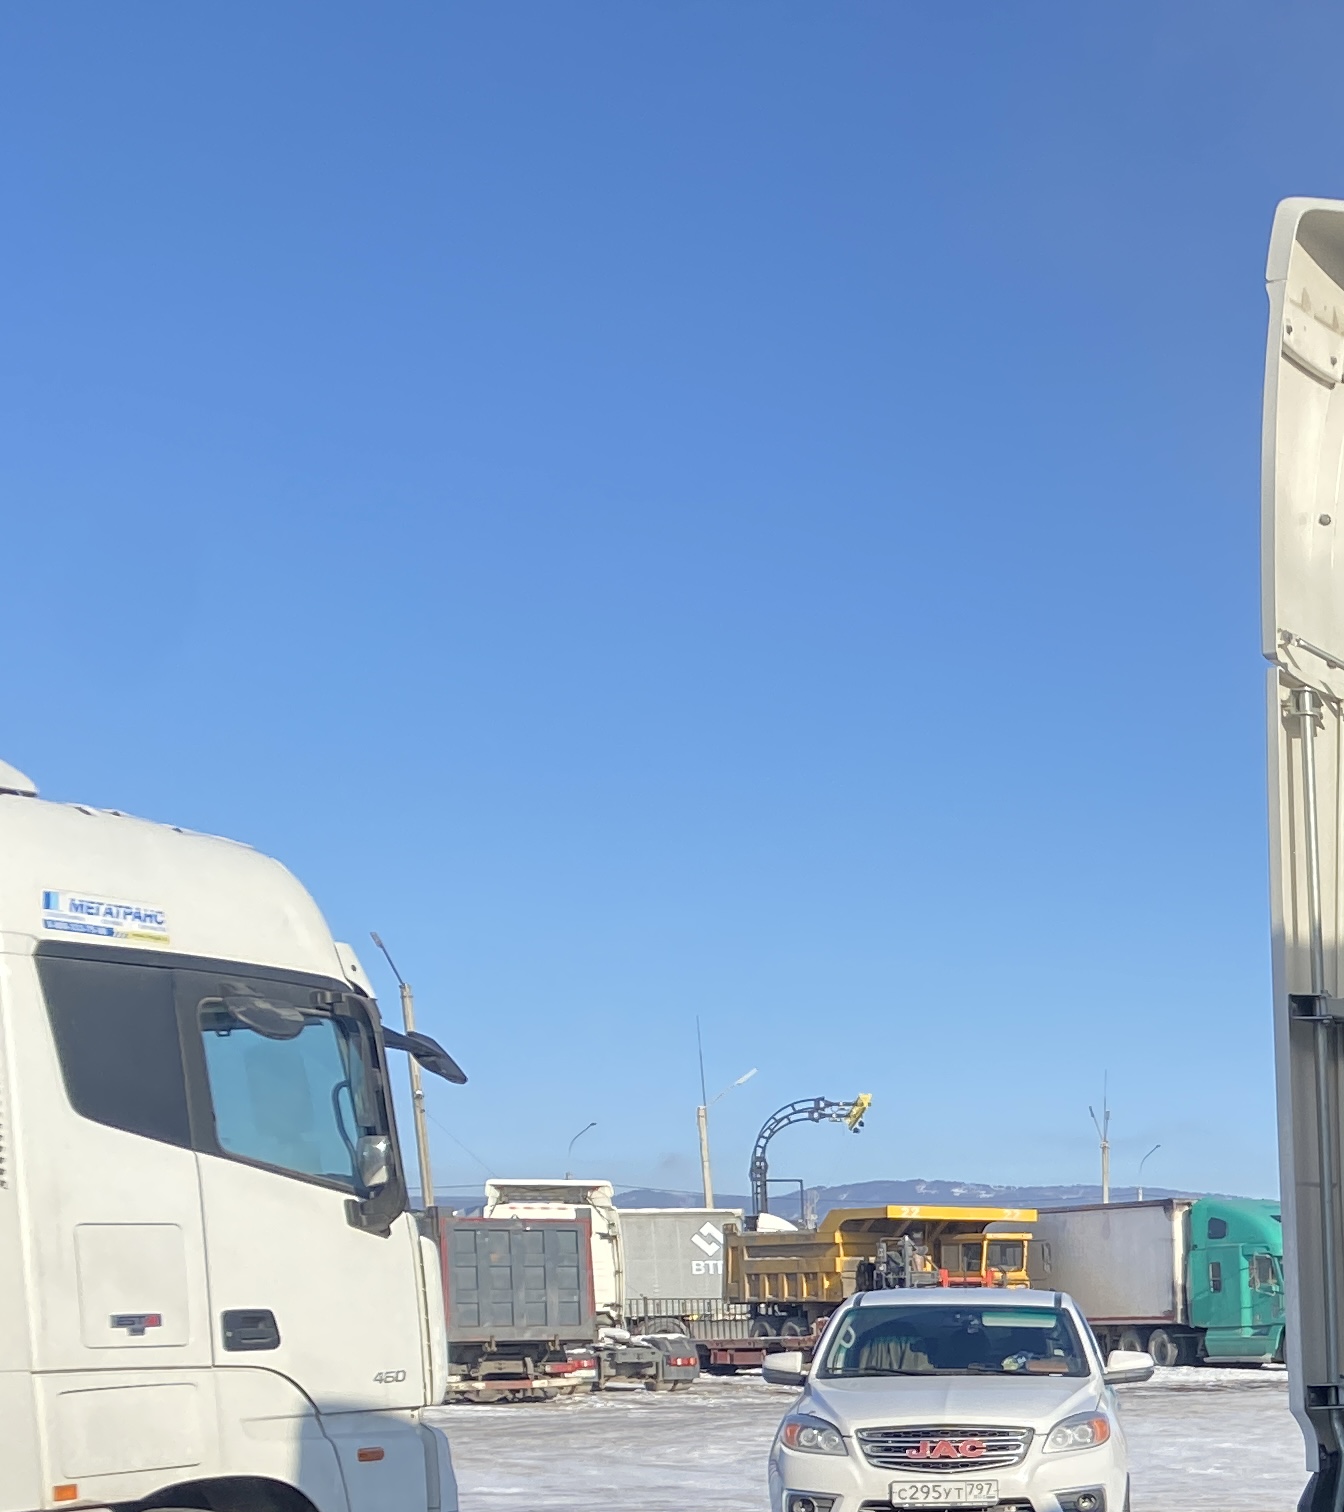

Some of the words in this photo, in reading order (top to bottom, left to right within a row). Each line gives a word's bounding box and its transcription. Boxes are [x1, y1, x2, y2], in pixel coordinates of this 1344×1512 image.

[373, 1369, 406, 1384] 460
[905, 1440, 987, 1459] JAC
[897, 1485, 964, 1501] С295УТ
[967, 1482, 993, 1496] 797
